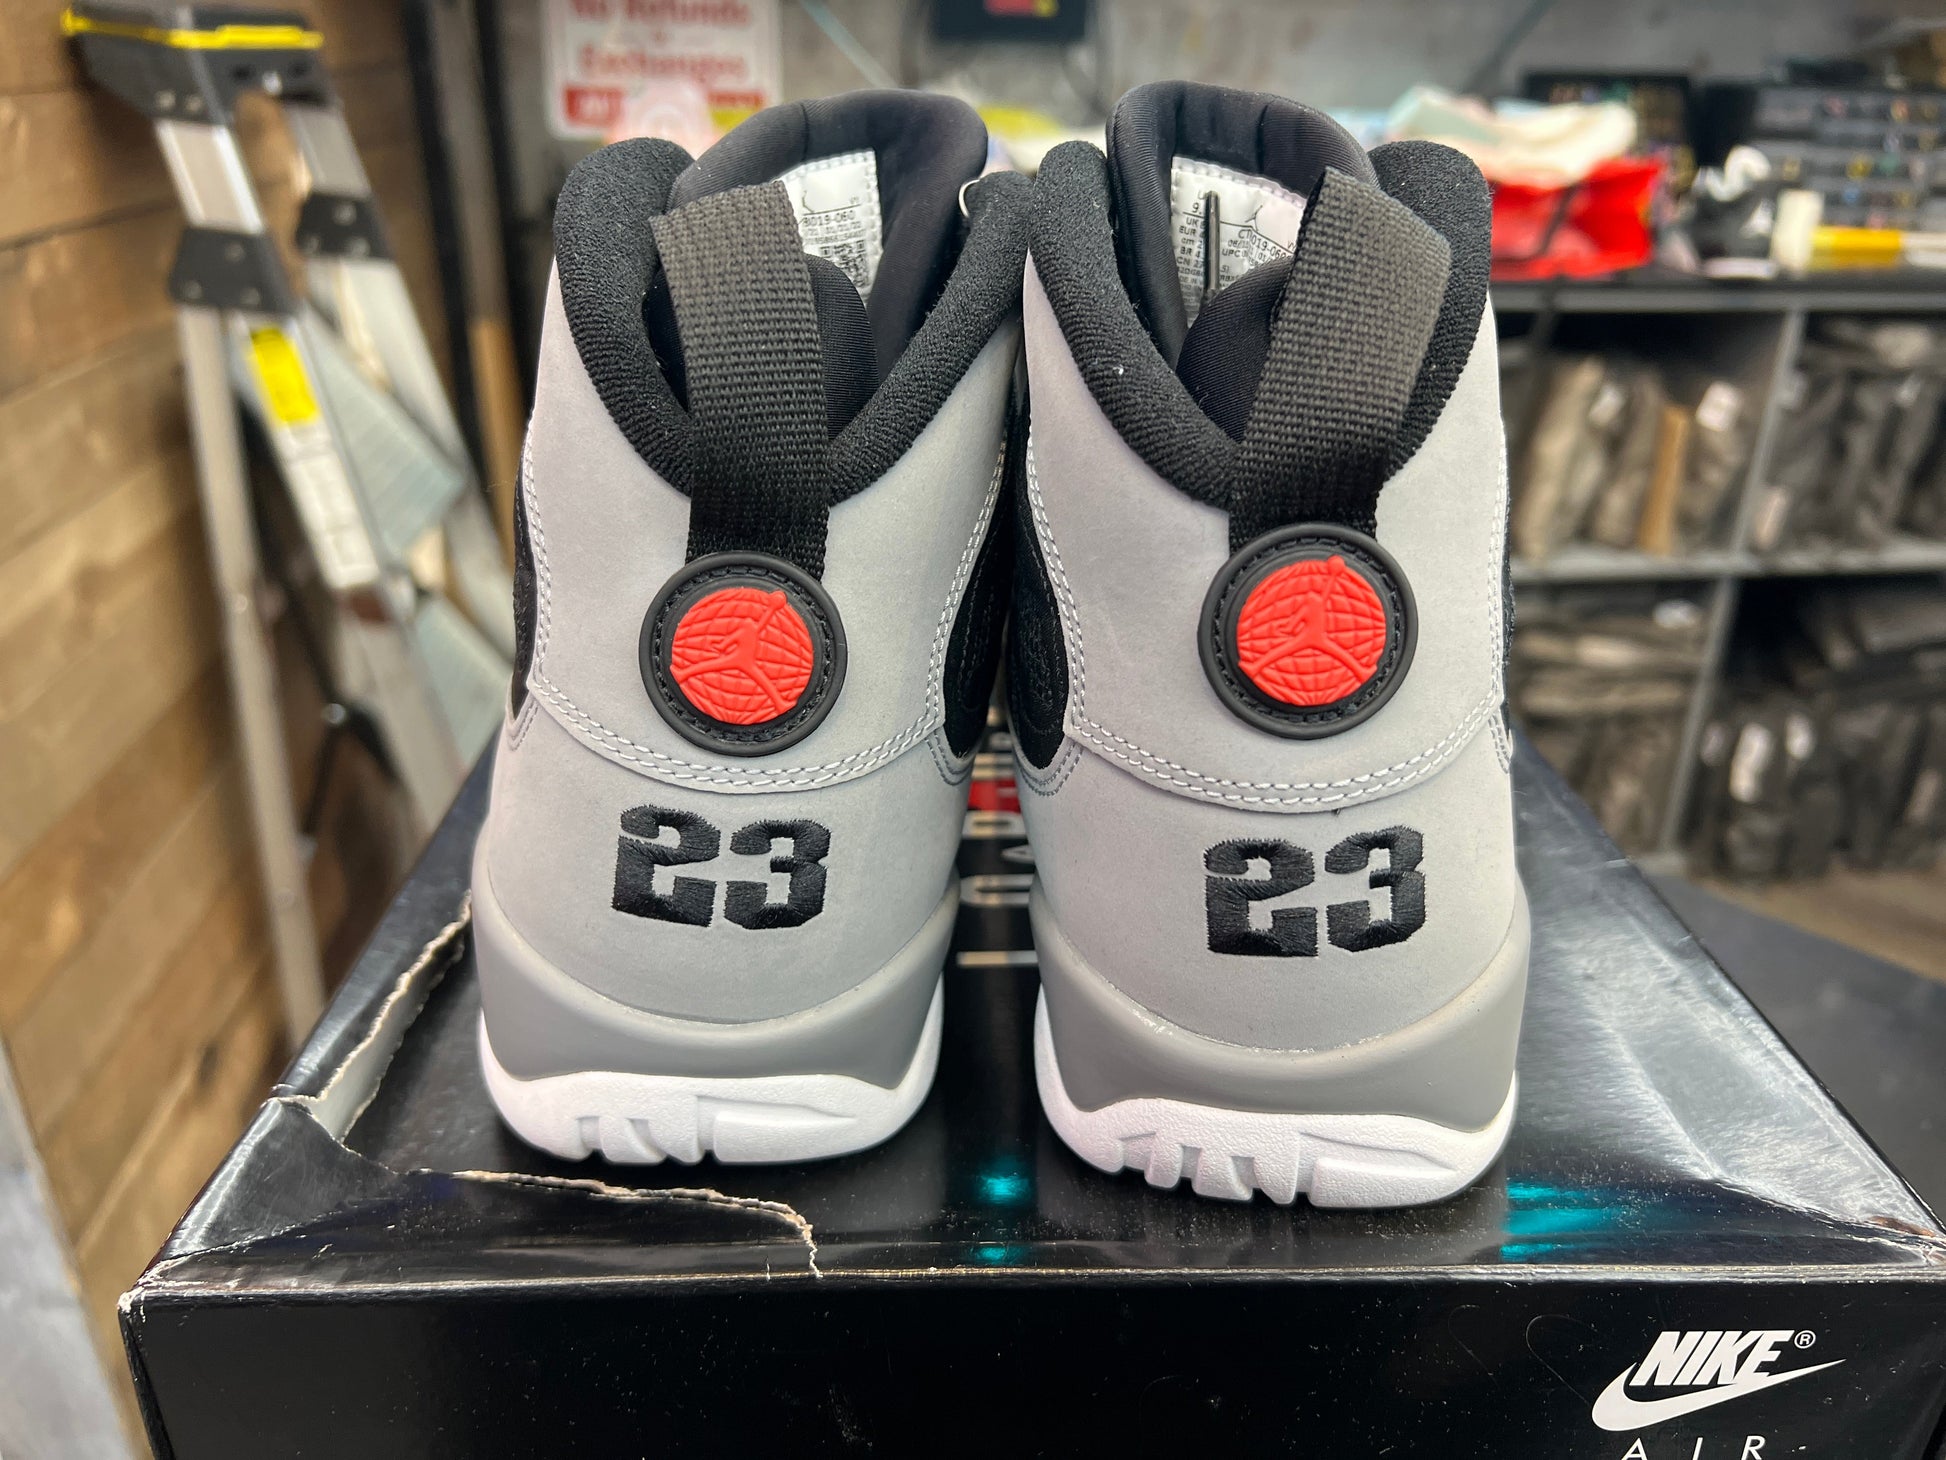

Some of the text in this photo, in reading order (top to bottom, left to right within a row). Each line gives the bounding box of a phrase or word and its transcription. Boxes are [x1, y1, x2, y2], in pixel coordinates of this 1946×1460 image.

[1179, 226, 1197, 237] EUR
[1186, 217, 1199, 226] UK
[1221, 250, 1240, 258] UPC
[612, 804, 831, 930] 23
[1203, 825, 1427, 957] 23
[1629, 1330, 1795, 1386] NIKE
[1621, 1436, 1767, 1460] AIR
